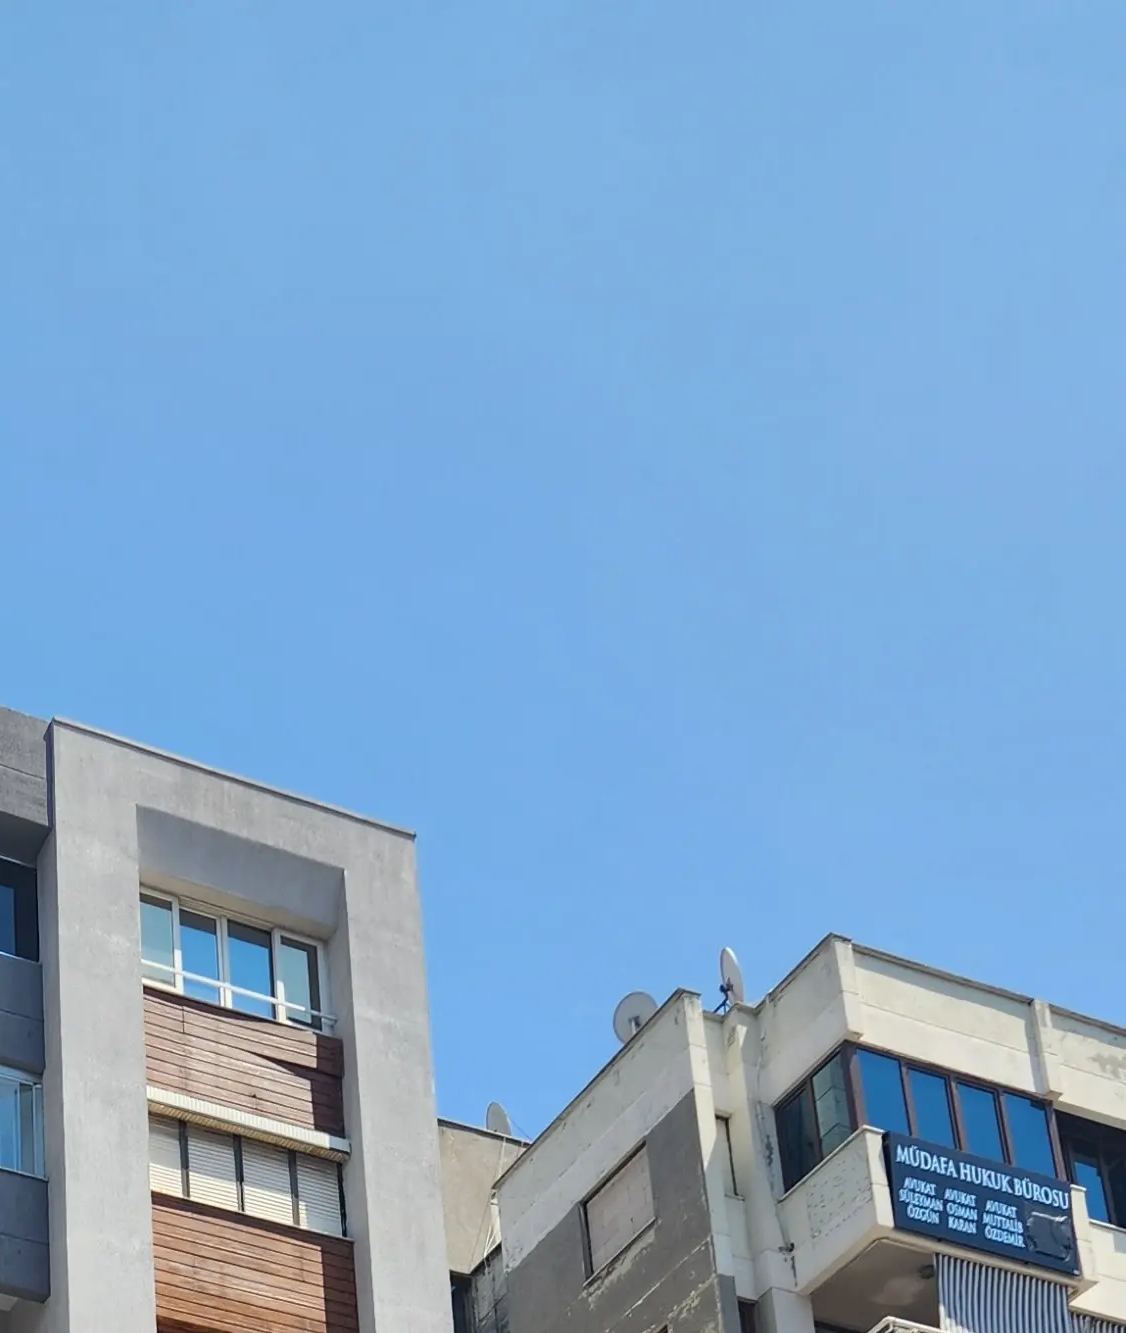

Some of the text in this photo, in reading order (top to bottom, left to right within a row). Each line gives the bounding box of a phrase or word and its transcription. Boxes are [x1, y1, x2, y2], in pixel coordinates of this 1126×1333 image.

[896, 1144, 1069, 1210] MÜDAFA HUKUK BÜROSU
[903, 1177, 937, 1196] AVUKAT
[944, 1188, 976, 1207] AVUKAT
[946, 1203, 978, 1222] OSMAN
[985, 1200, 1018, 1218] AVUKAT
